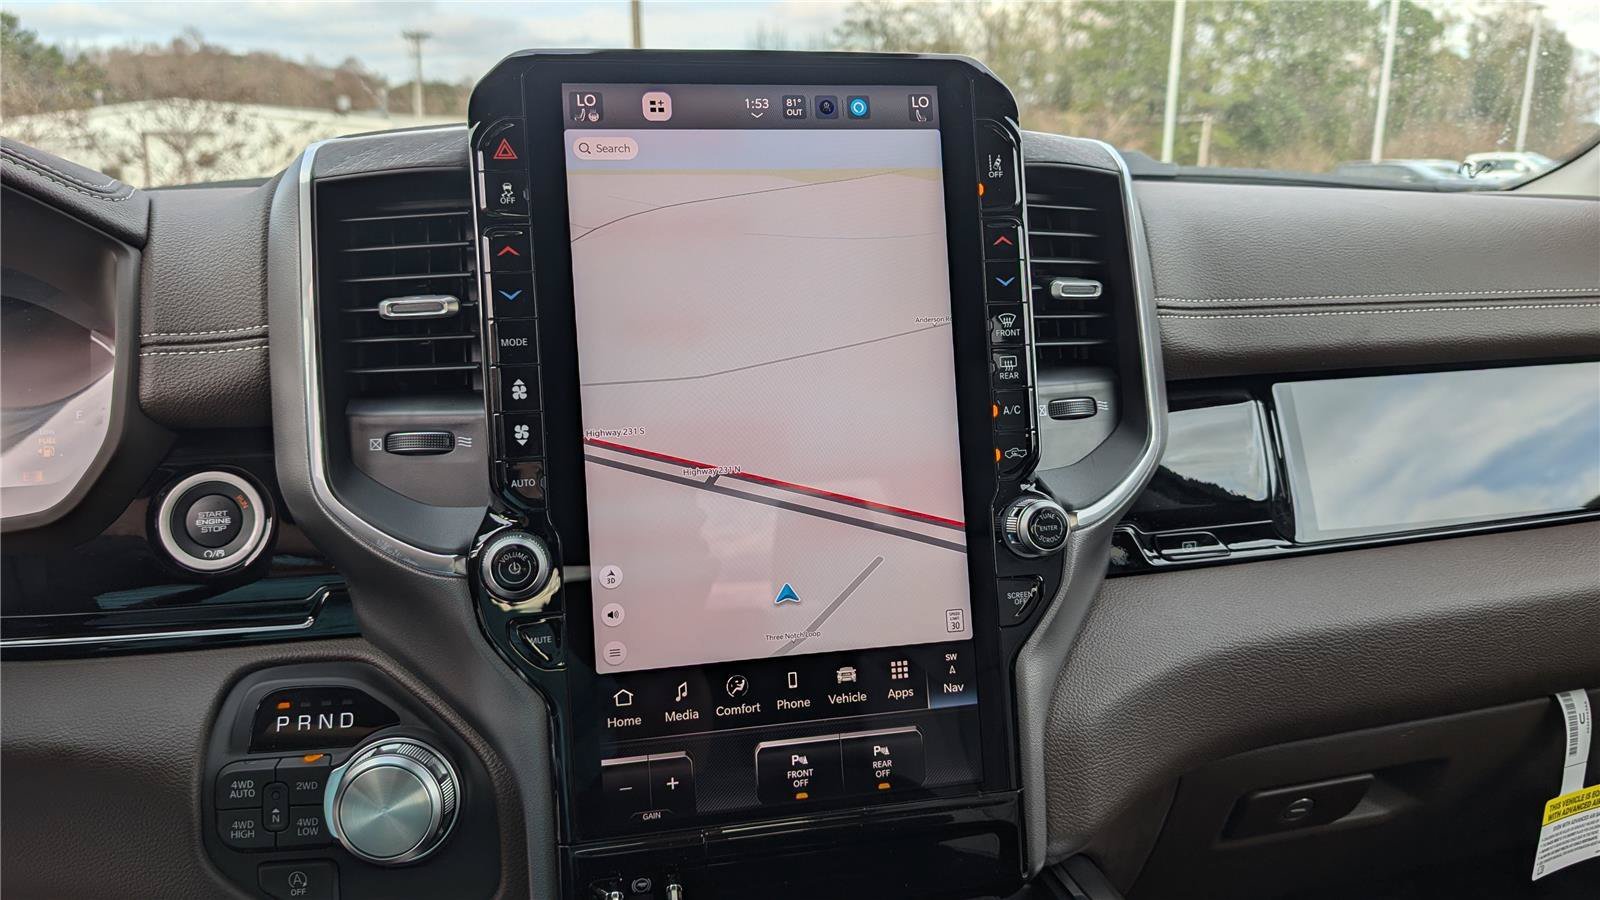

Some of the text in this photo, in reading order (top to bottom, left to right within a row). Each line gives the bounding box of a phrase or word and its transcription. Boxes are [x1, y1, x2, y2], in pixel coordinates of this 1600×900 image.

[576, 94, 597, 107] LO
[744, 98, 769, 109] 1:53
[786, 98, 802, 107] 81°
[911, 95, 930, 108] LO
[786, 108, 803, 116] OUT
[595, 143, 631, 153] Search
[500, 196, 516, 205] OFF
[995, 328, 1021, 337] FRONT
[500, 338, 529, 347] MODE
[999, 372, 1019, 380] REAR
[1002, 405, 1021, 415] A/C
[585, 427, 645, 439] Highway 231 S
[682, 465, 741, 477] Highway 231 N
[510, 478, 536, 488] AUTO
[198, 510, 229, 520] START
[1039, 512, 1056, 520] TUNE
[195, 517, 232, 526] ENGINE
[200, 525, 227, 534] STOP
[1039, 534, 1060, 543] SCROLL
[499, 551, 529, 563] VOLUME
[606, 577, 616, 585] 3D
[1007, 591, 1034, 600] SCREEN
[951, 621, 960, 630] 30
[530, 636, 552, 644] MUTE
[945, 653, 957, 661] SW
[943, 683, 964, 693] Nav
[828, 691, 867, 705] Vehicle
[887, 689, 914, 700] Apps
[716, 702, 761, 717] Comfort
[776, 698, 811, 711] Phone
[664, 709, 700, 723] Media
[276, 712, 354, 732] P R N D
[607, 716, 642, 729] Home
[872, 759, 892, 769] REAR
[787, 768, 814, 779] FRONT
[875, 769, 890, 778] OFF
[231, 780, 254, 789] 4WD
[296, 781, 318, 790] 2WD
[793, 779, 809, 788] OFF
[229, 789, 255, 799] AUTO
[1549, 801, 1561, 811] THIS
[1561, 793, 1584, 807] VEHICLE
[642, 811, 661, 821] GAIN
[1547, 811, 1562, 821] WITH
[1562, 801, 1591, 815] ADVANCED
[271, 814, 280, 823] N
[296, 817, 319, 826] 4WD
[231, 820, 254, 829] 4WD
[230, 829, 255, 839] HIGH
[297, 826, 319, 836] LOW
[290, 887, 307, 896] OFF
